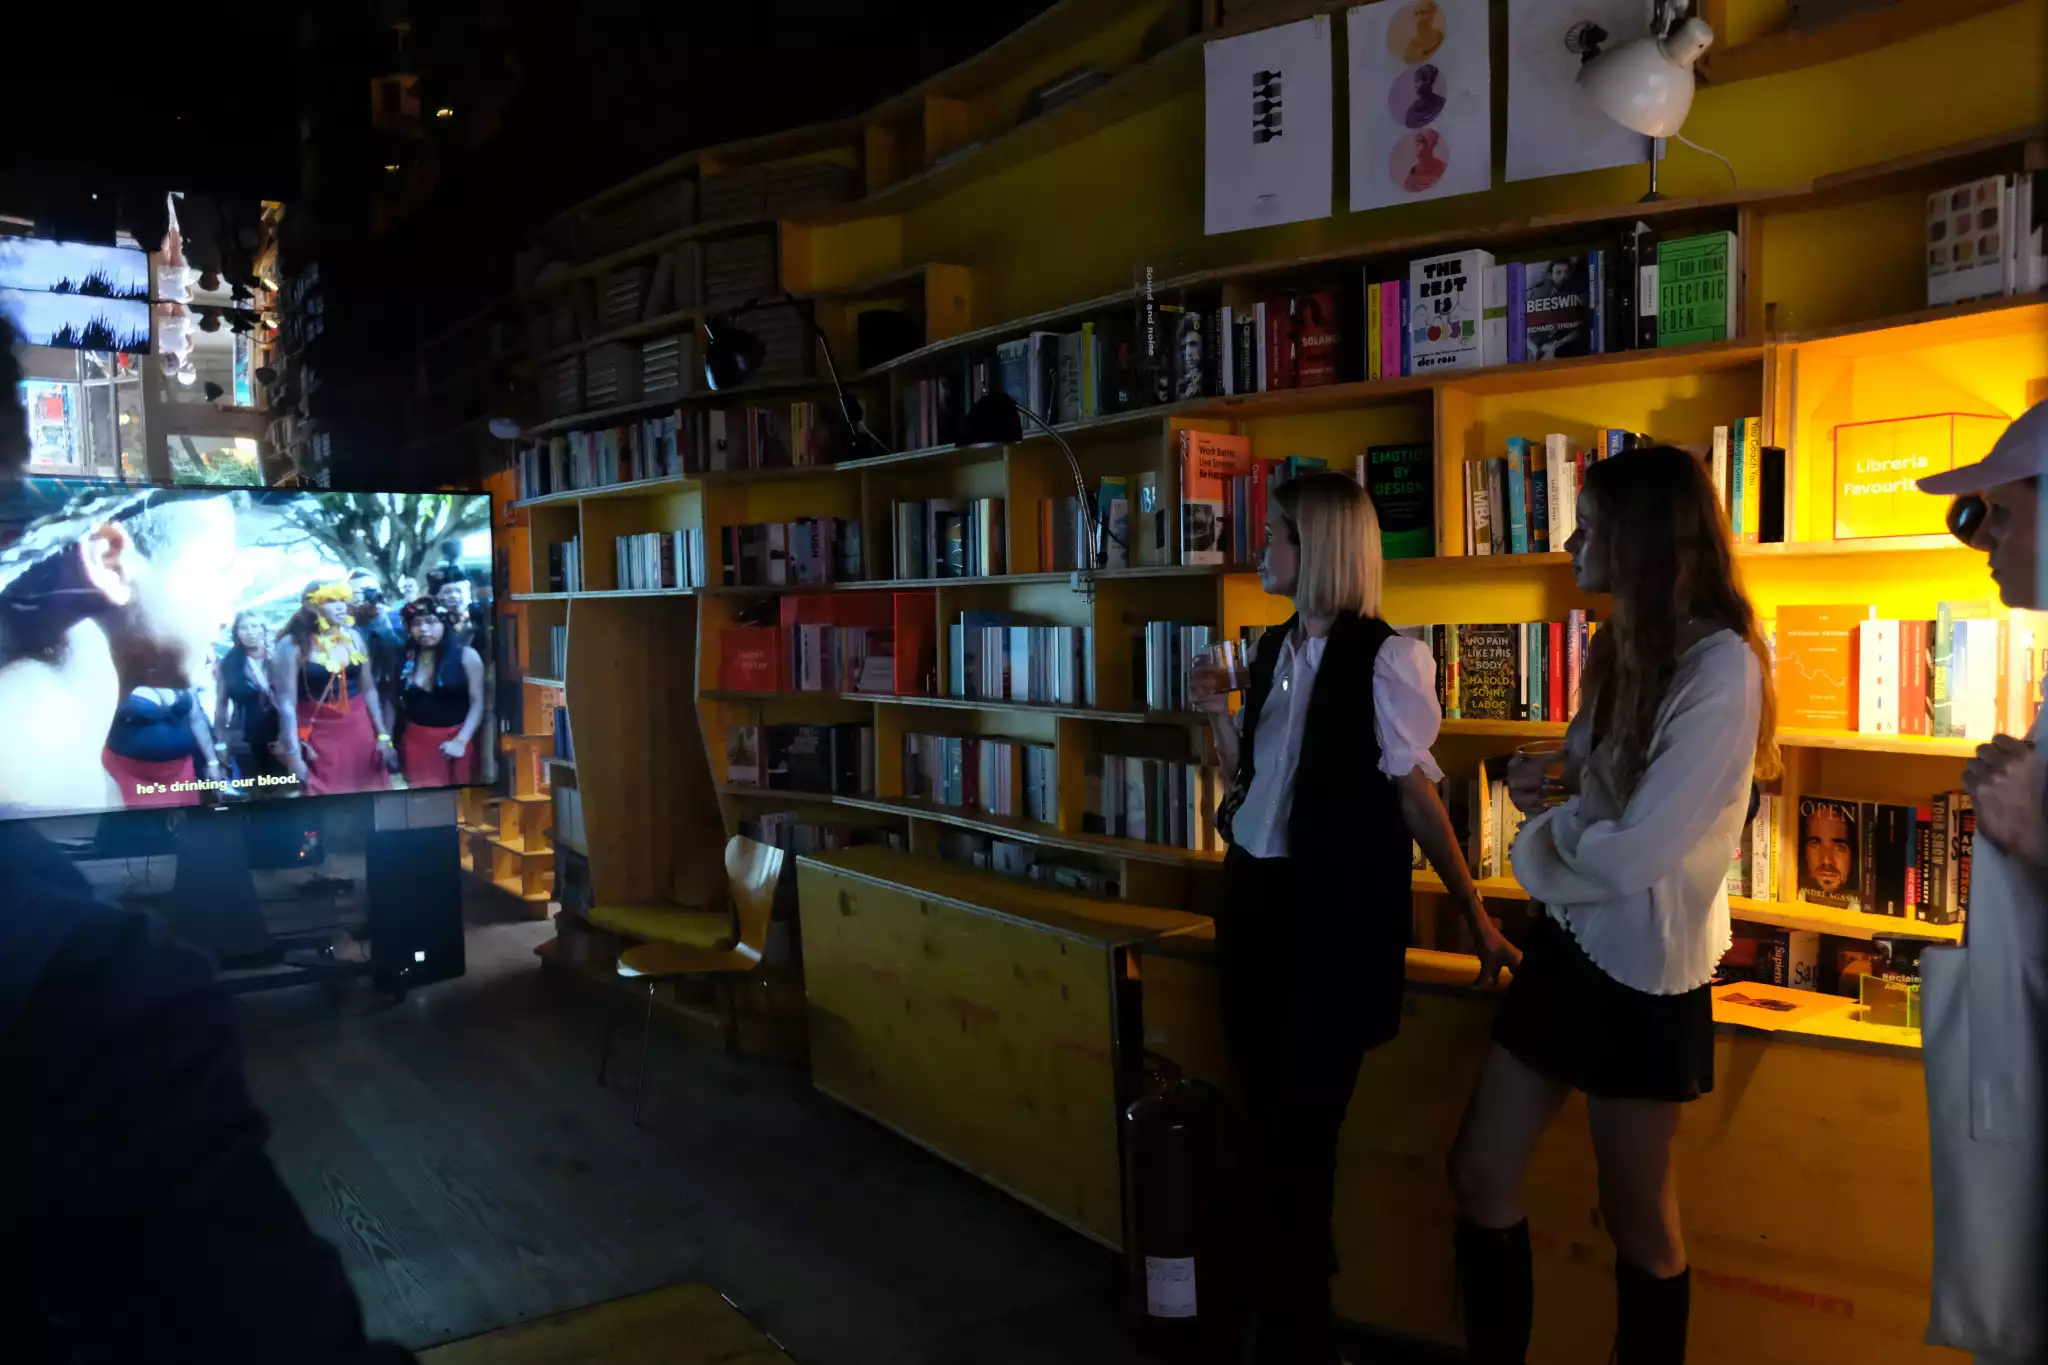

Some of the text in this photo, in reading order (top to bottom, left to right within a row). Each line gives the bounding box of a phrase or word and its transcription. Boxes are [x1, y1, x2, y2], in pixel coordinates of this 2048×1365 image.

[1424, 259, 1461, 278] THE
[1420, 276, 1467, 297] REST
[1663, 278, 1723, 307] ELECTRIC
[1146, 266, 1155, 356] Sound and noise
[1434, 297, 1452, 314] IS
[1663, 307, 1694, 331] EDEN
[1527, 323, 1554, 333] RICHARD
[1438, 356, 1456, 364] ross
[1751, 421, 1759, 438] You
[1199, 445, 1216, 457] Work
[1372, 447, 1423, 464] EMOTIO
[1750, 440, 1758, 468] Coach
[1394, 465, 1410, 478] BY
[1857, 454, 1928, 473] Libreria
[1199, 469, 1207, 478] Be
[1373, 481, 1426, 495] DESIGN
[1844, 476, 1918, 496] Favourit
[1469, 637, 1509, 646] NO PAIN
[1467, 648, 1511, 658] LIKE THIS
[1476, 660, 1503, 670] BODY
[1469, 675, 1509, 685] HAROLD
[1472, 687, 1506, 697] SONNY
[136, 773, 300, 795] he's drinking our blood.
[1800, 800, 1855, 823] OPEN
[1931, 833, 1945, 864] SHOW
[1830, 892, 1858, 902] AGASSI
[1772, 947, 1785, 984] Sapiens
